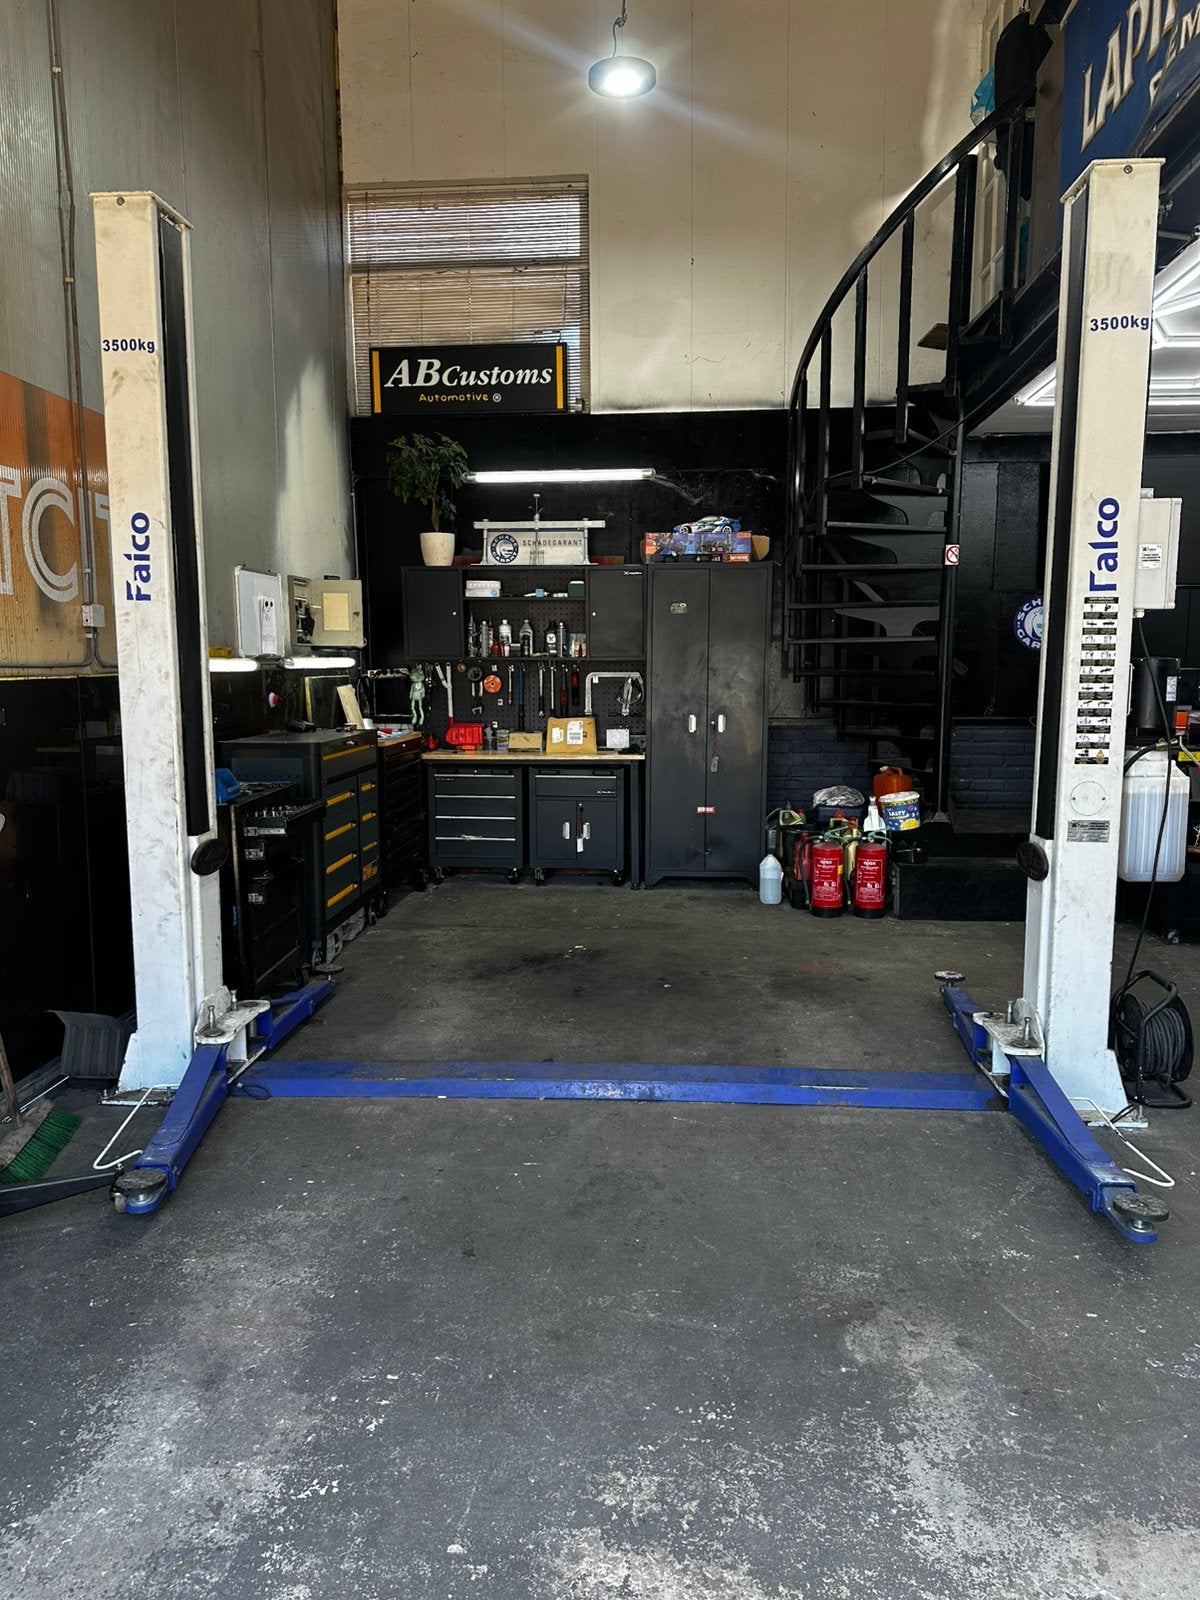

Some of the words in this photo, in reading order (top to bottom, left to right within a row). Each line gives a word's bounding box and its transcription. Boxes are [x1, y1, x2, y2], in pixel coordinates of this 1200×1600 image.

[1090, 315, 1149, 331] 3500kg
[103, 338, 155, 353] 3500kg
[419, 392, 489, 402] Automotive
[522, 539, 582, 547] SCHADEGARANT
[1088, 497, 1120, 591] Falco
